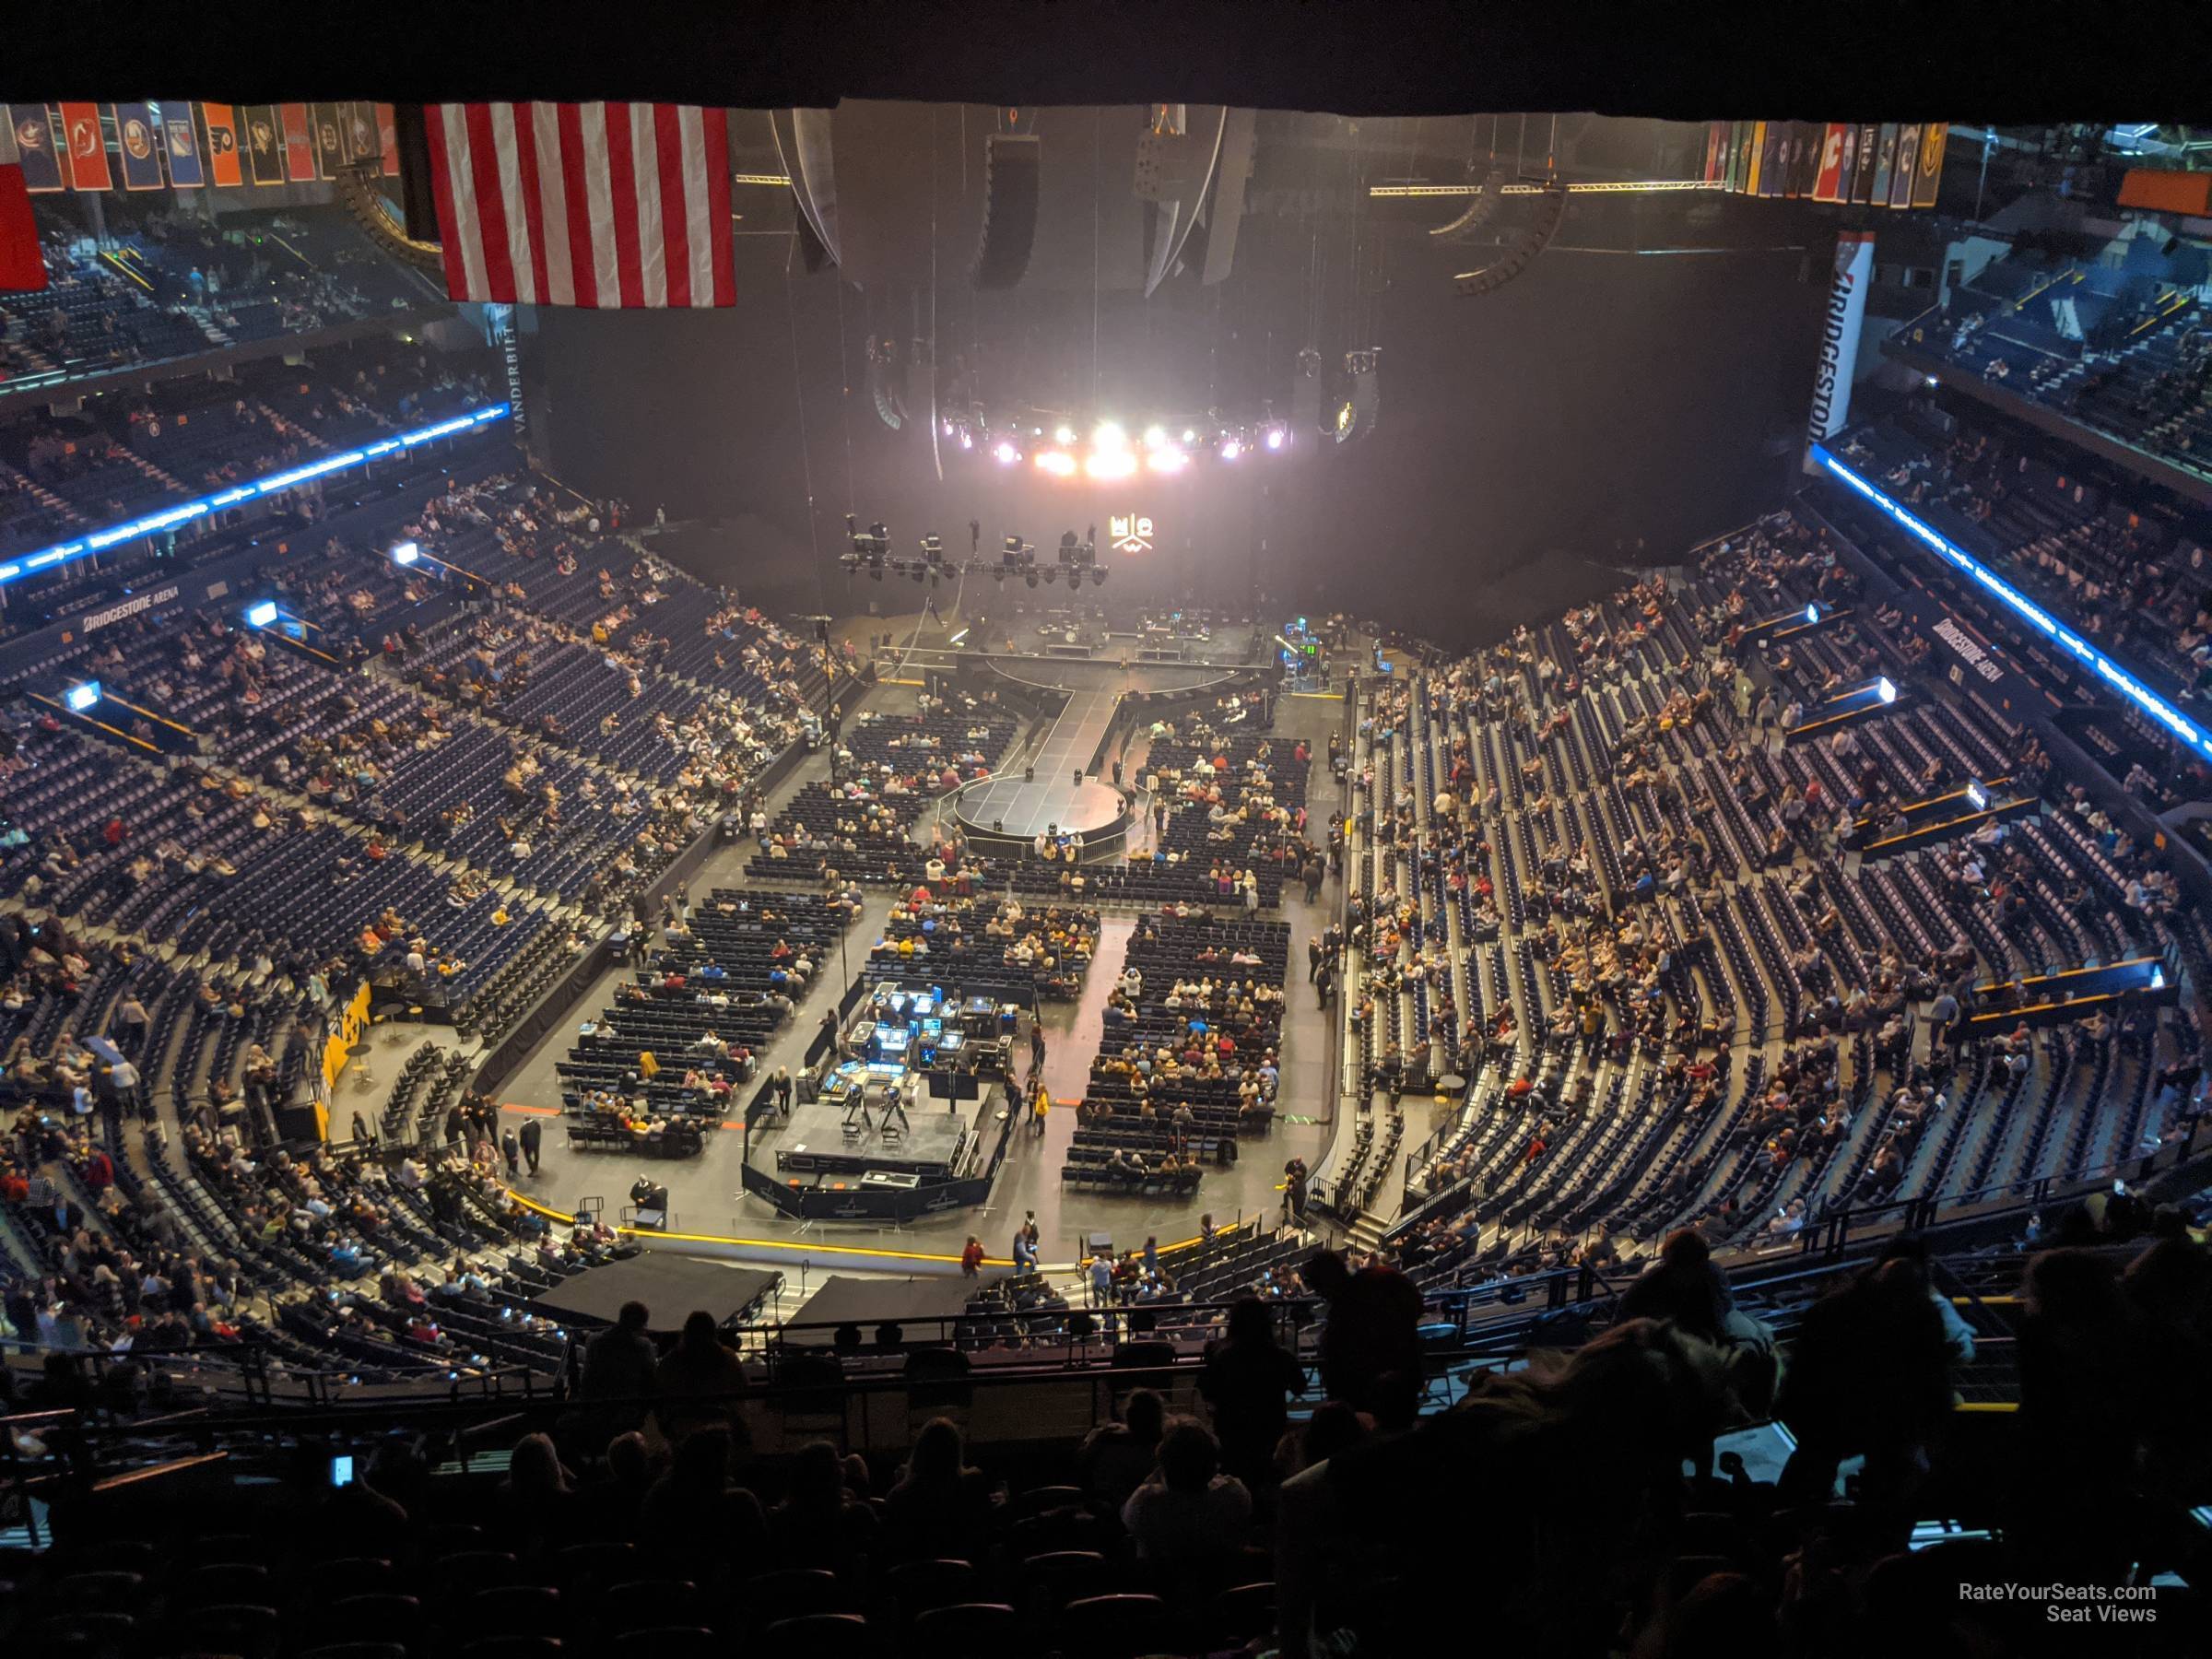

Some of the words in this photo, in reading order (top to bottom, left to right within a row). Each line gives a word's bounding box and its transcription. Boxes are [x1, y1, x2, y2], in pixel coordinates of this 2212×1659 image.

[503, 325, 526, 434] VANDERBILT
[1808, 273, 1854, 442] BRIDGESTON
[83, 594, 151, 633] BRIDGESTONE
[153, 585, 179, 606] ARENA
[1932, 618, 1988, 665] BRIDGESTONE
[1975, 658, 2005, 683] ARENA
